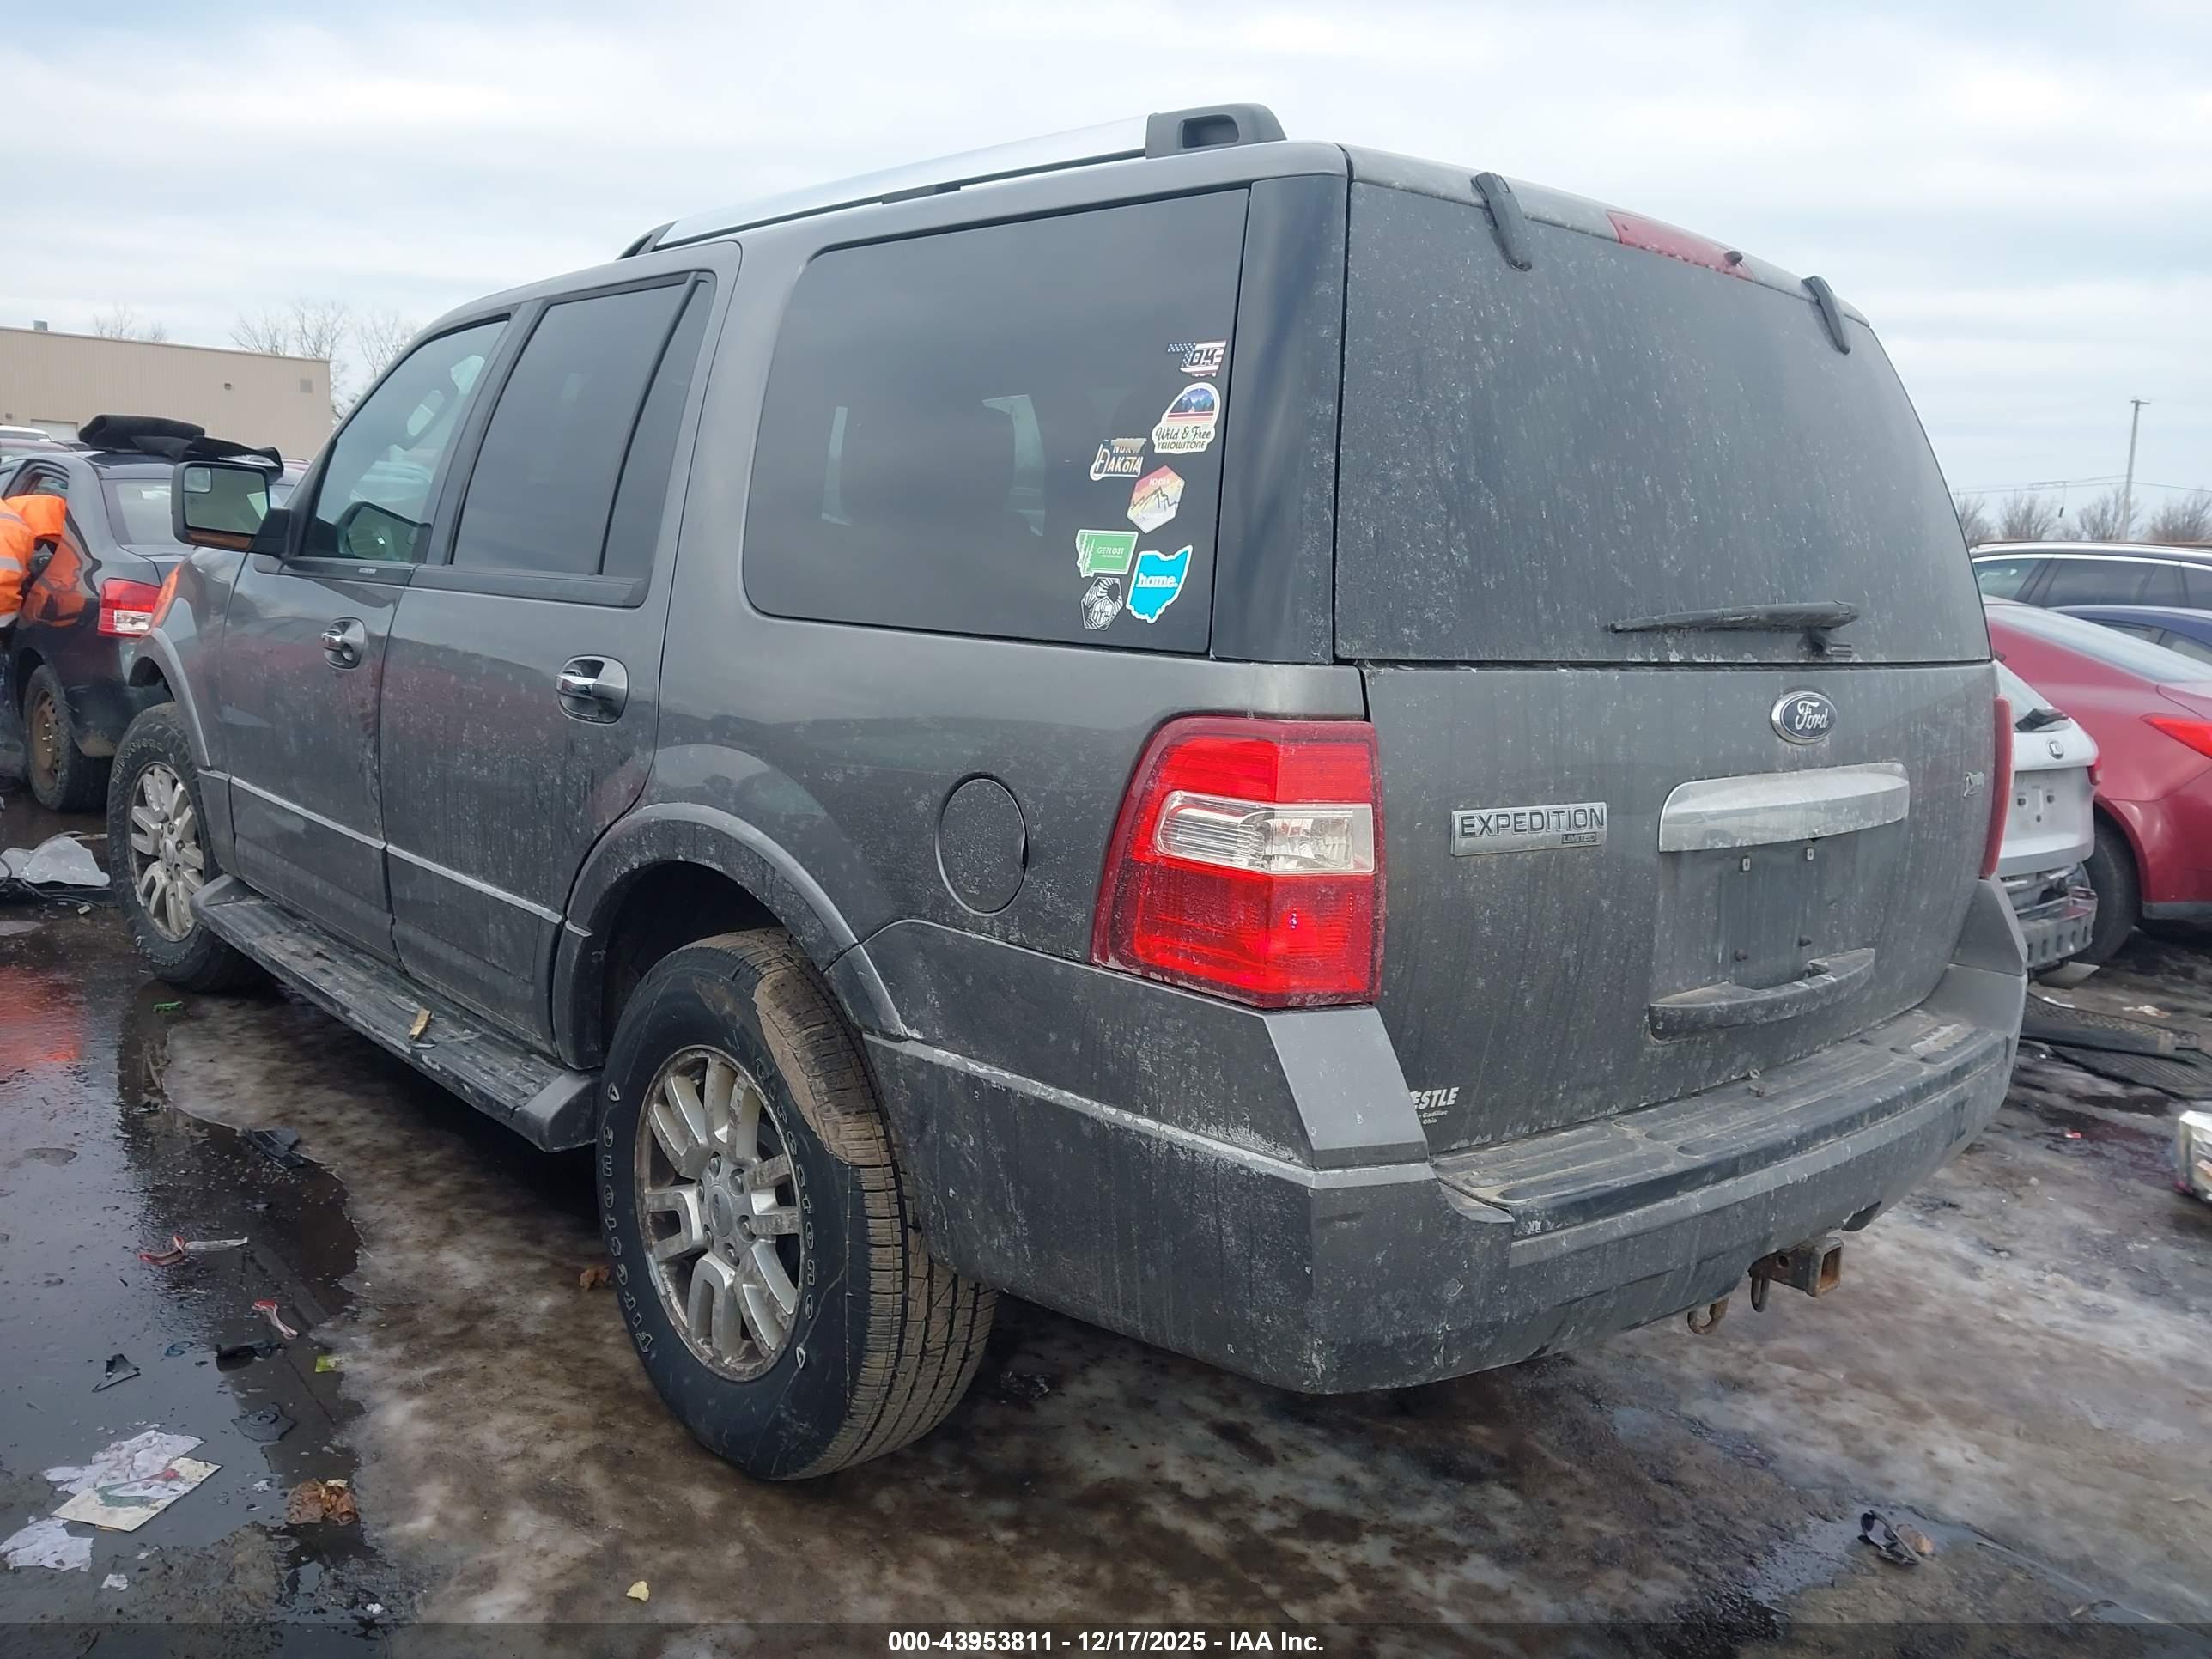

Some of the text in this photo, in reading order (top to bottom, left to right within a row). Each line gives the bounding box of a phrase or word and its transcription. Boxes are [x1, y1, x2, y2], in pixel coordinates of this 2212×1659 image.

[1155, 425, 1212, 441] Wild & Free
[1095, 448, 1142, 474] DAKOTA
[1795, 700, 1830, 730] Ford
[1460, 807, 1605, 837] EXPEDITION
[1410, 1087, 1460, 1109] ESTLE
